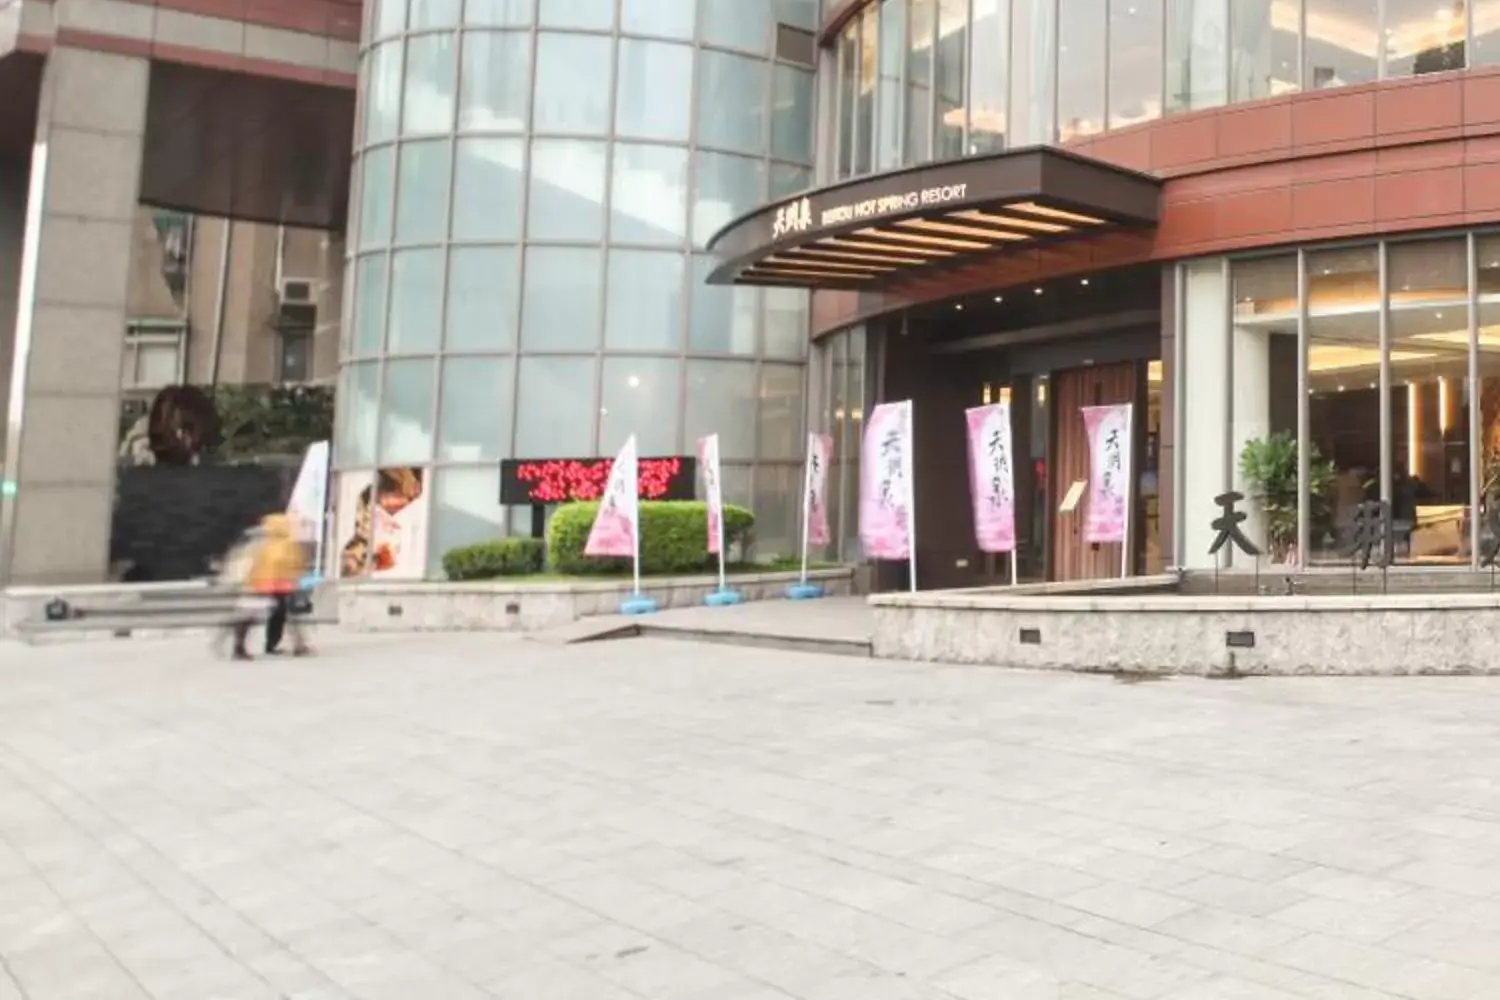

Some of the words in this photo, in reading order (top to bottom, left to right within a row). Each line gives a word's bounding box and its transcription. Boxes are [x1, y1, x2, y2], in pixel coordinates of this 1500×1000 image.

[855, 200, 877, 217] HOT
[878, 191, 919, 213] SPRING
[921, 184, 967, 205] RESORT
